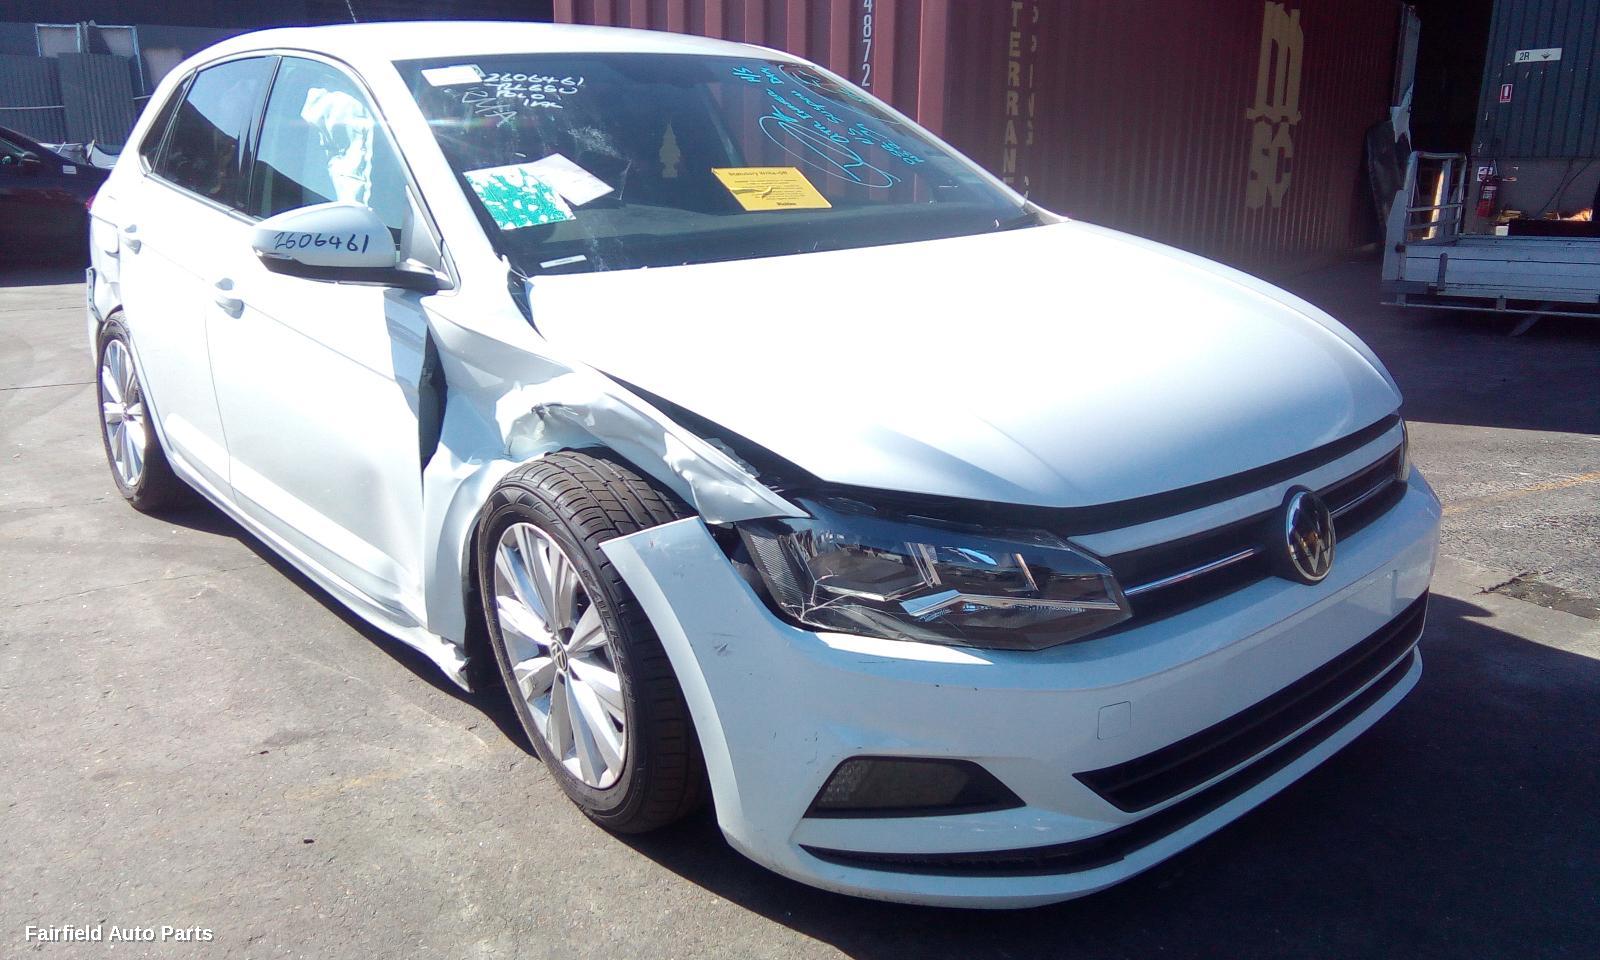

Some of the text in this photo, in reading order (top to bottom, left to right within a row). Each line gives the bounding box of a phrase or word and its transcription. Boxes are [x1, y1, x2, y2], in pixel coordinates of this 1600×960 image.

[483, 73, 584, 86] 2606461
[1001, 2, 1023, 185] TERRAN
[273, 231, 370, 254] 2606461
